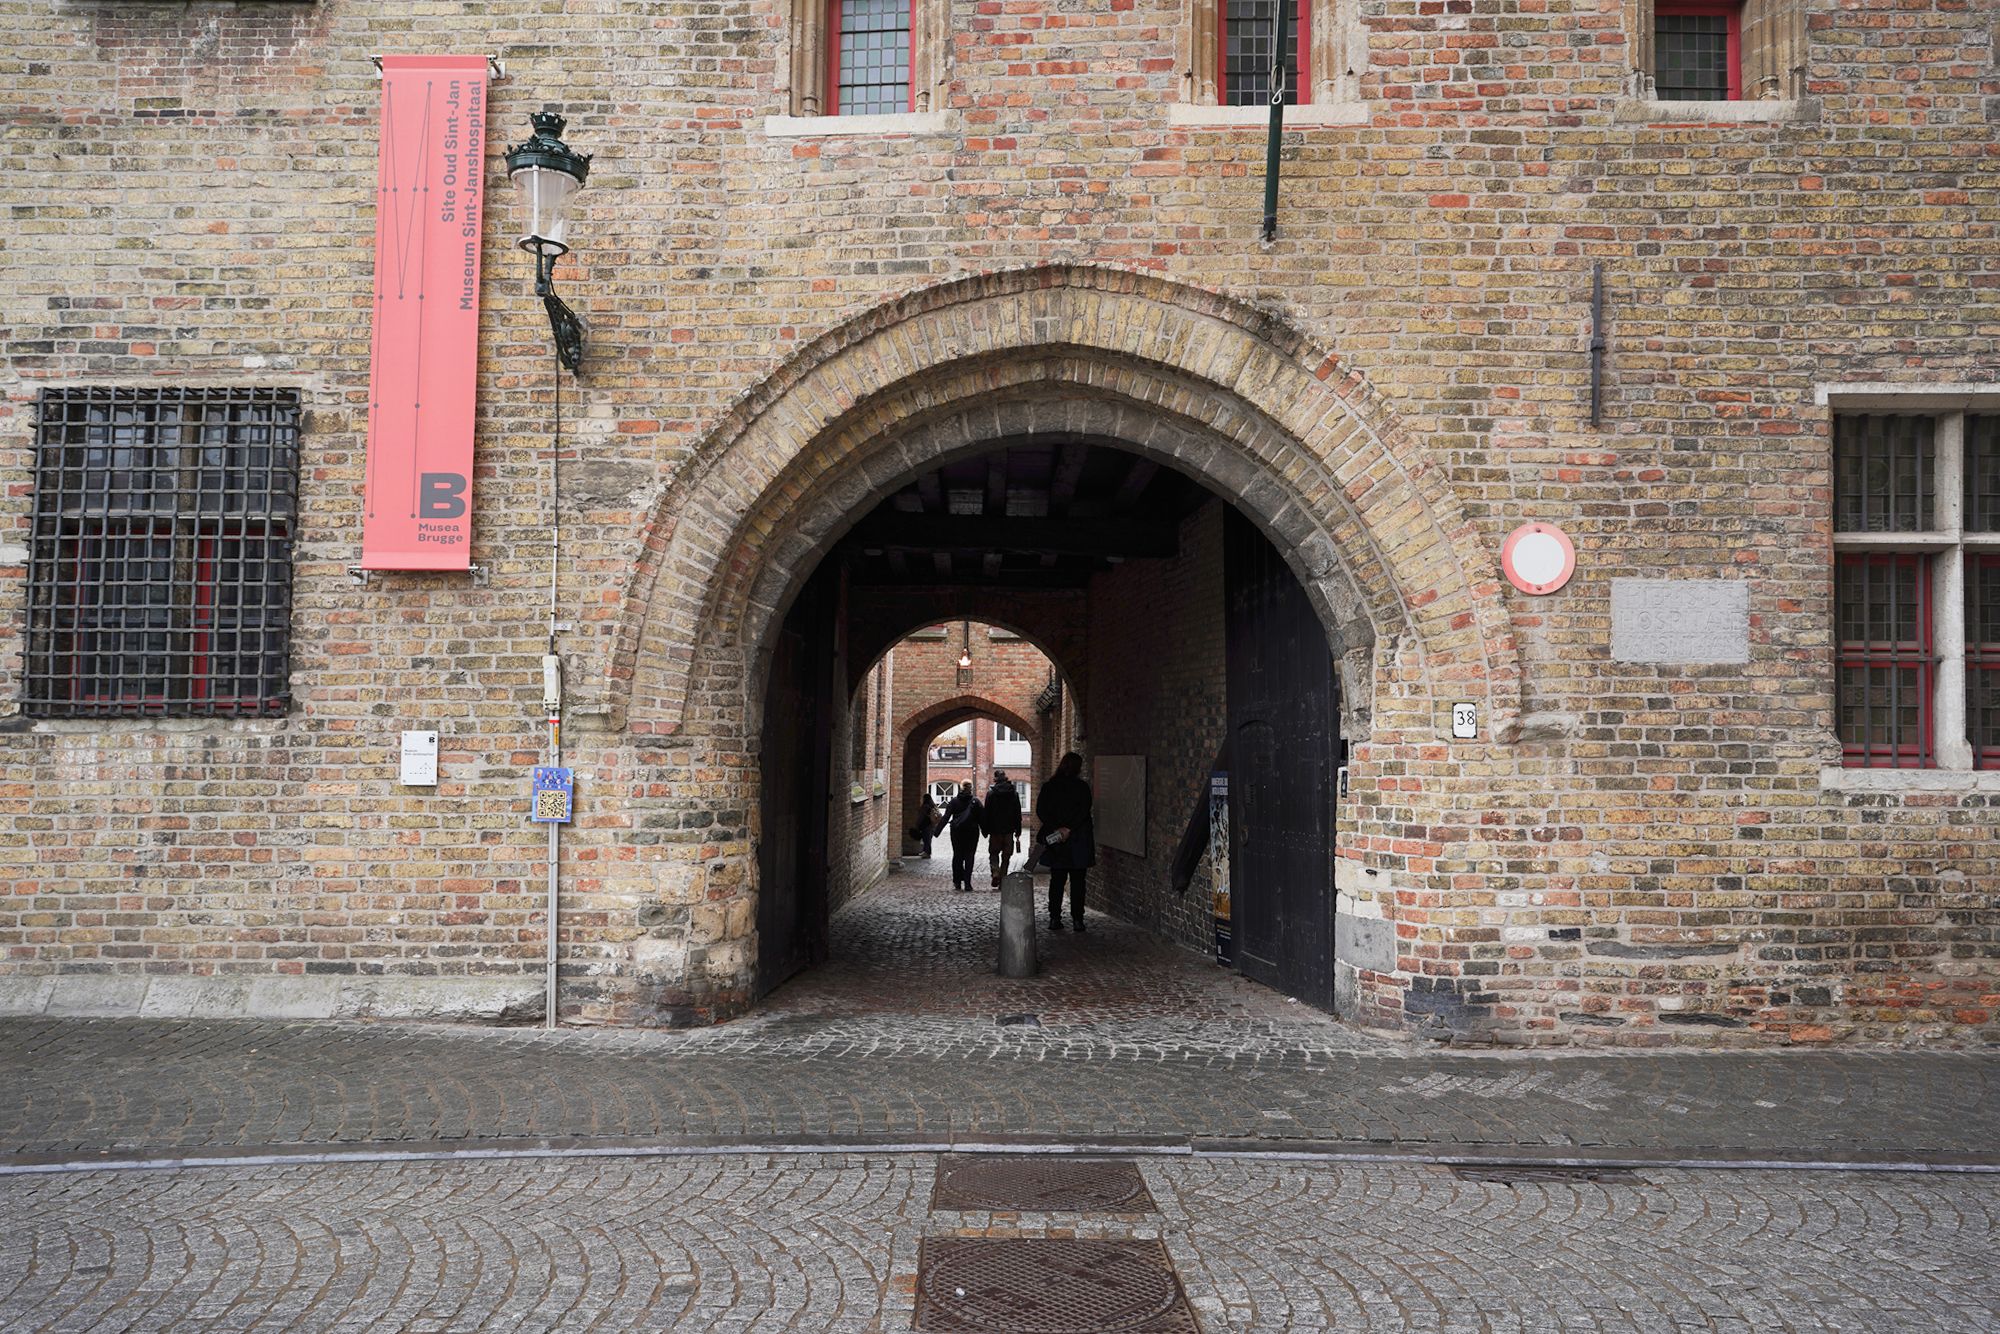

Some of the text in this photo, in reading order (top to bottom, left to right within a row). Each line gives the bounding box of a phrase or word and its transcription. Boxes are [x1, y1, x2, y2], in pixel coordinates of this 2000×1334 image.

[442, 80, 460, 222] Site Oud Sint-Jan
[460, 80, 483, 310] Museum Sint-Janshospitaal
[419, 473, 466, 518] B
[417, 533, 463, 545] Brugge
[418, 523, 460, 532] Musea
[1457, 711, 1475, 726] 38
